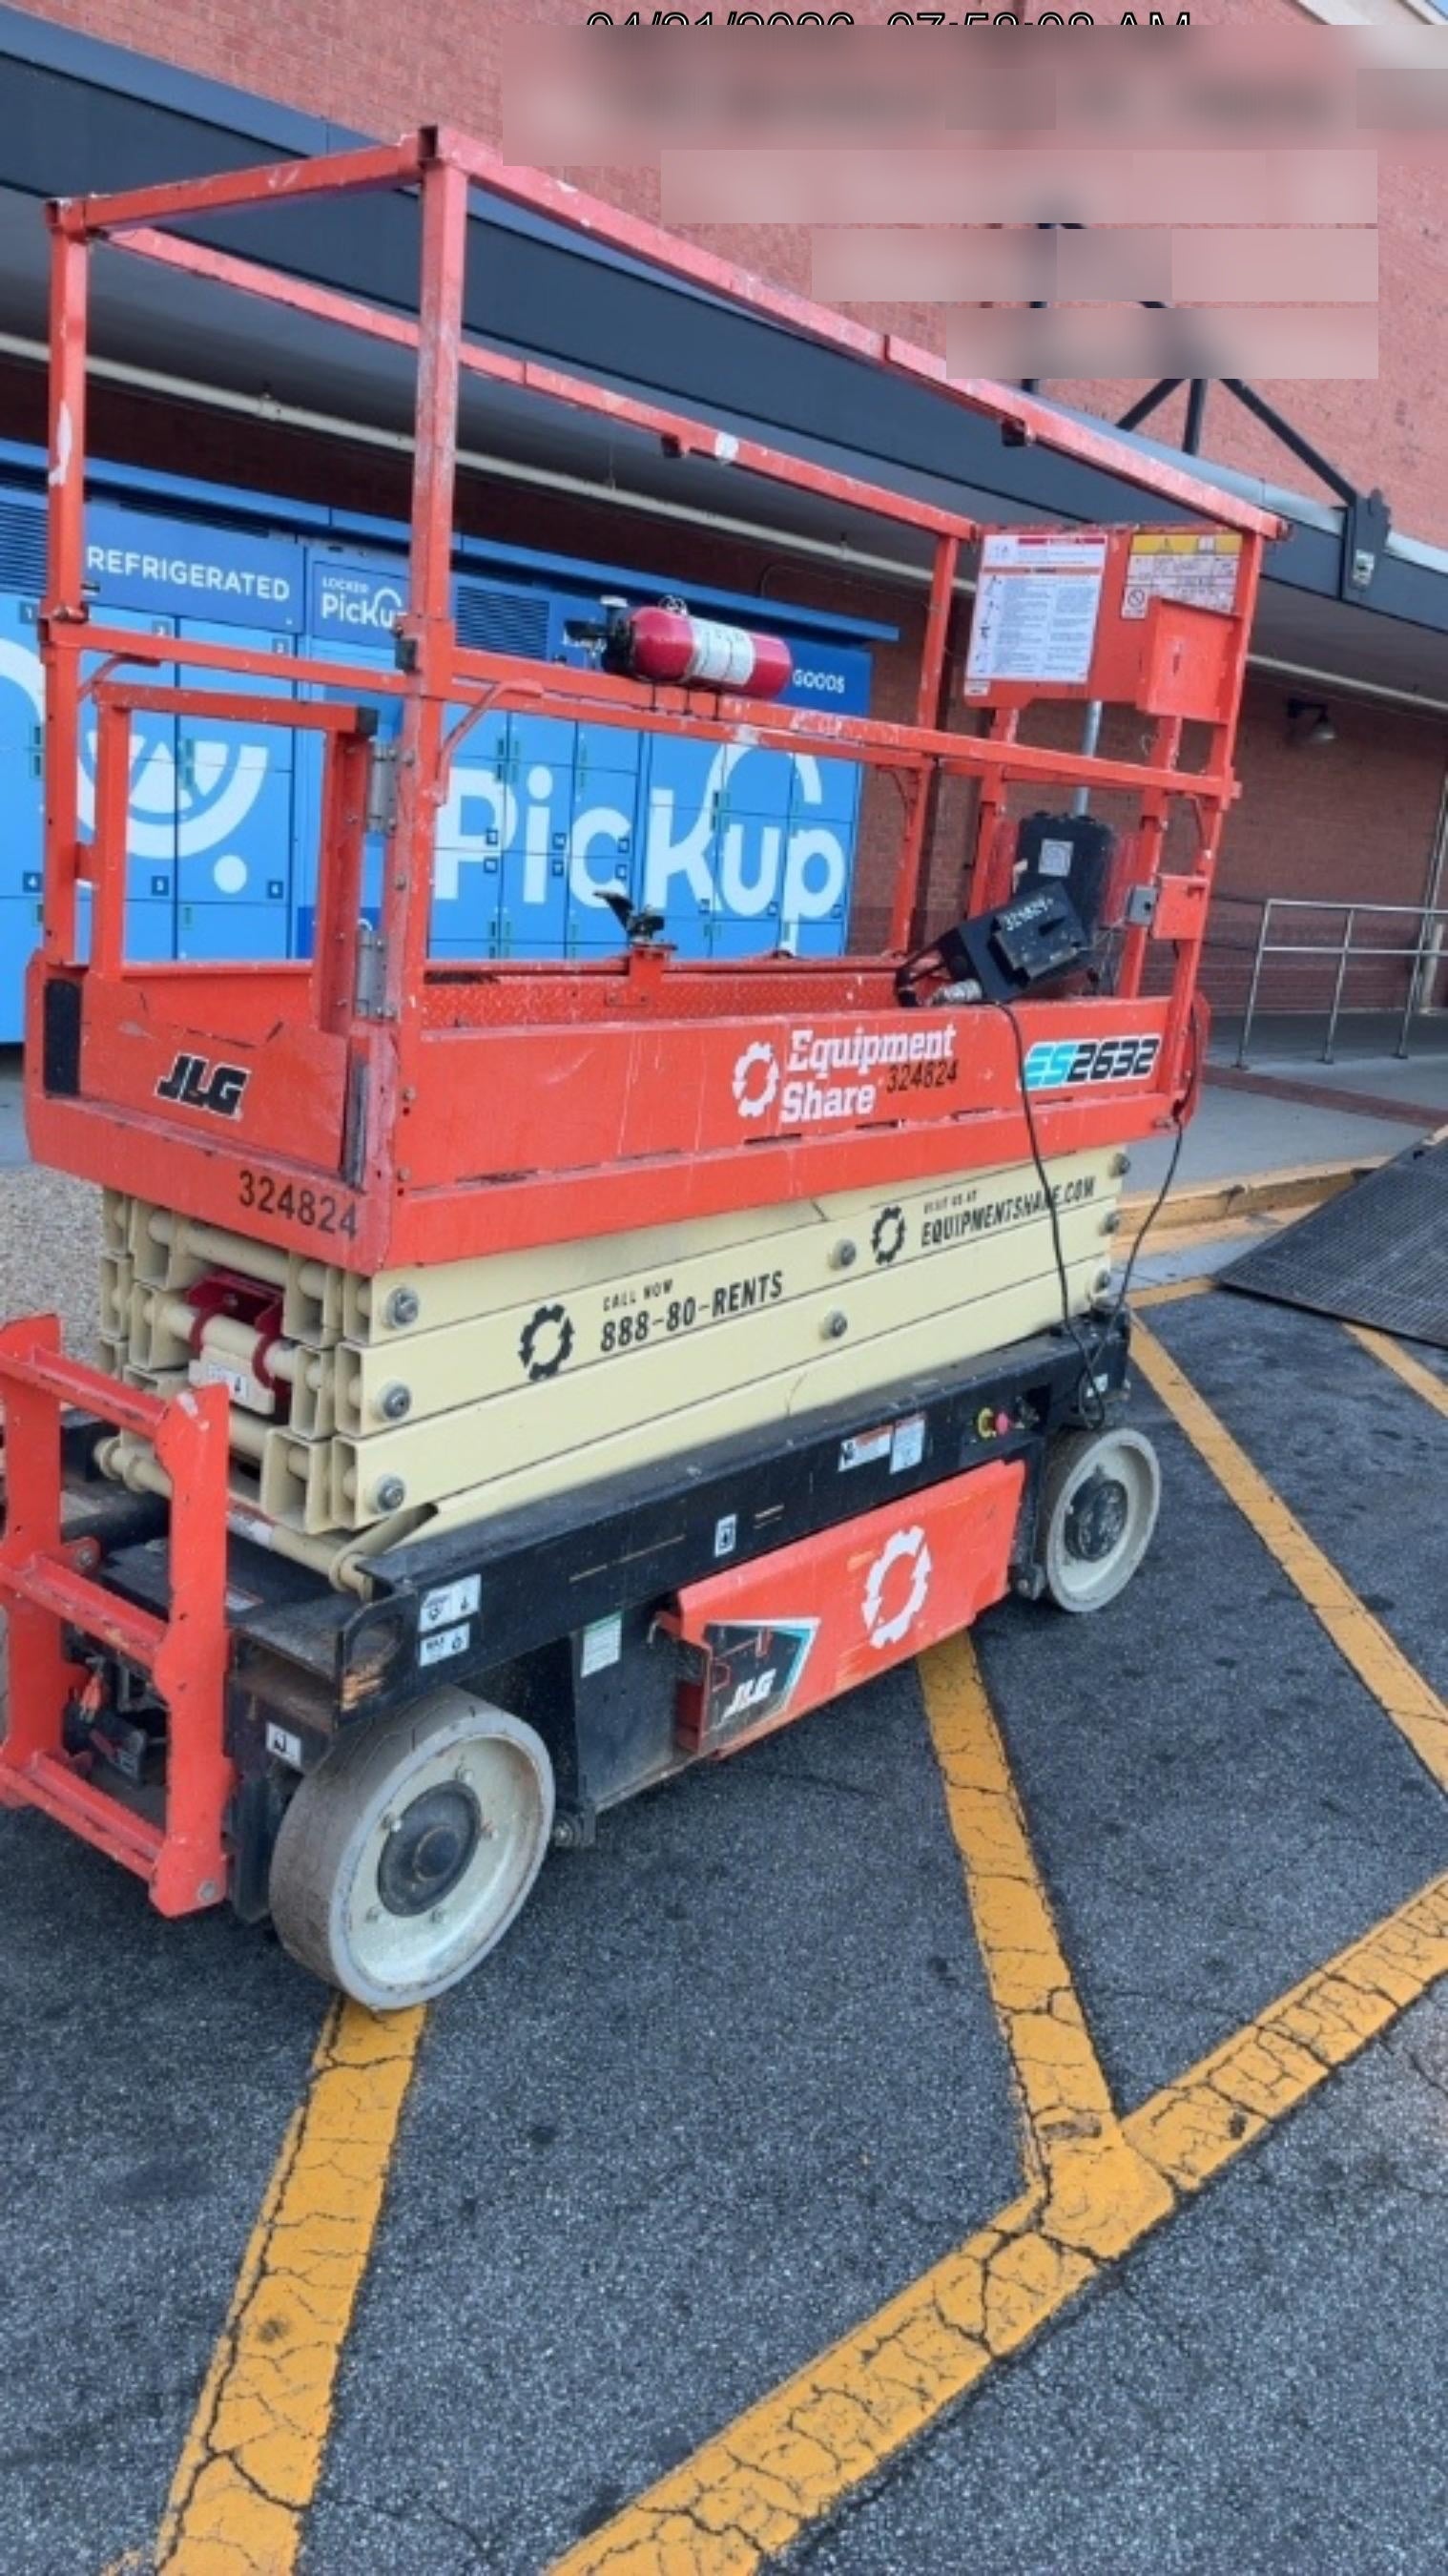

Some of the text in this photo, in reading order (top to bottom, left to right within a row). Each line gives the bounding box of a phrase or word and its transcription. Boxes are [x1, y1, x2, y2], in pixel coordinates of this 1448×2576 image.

[88, 547, 290, 601] REFRIGERATED
[322, 576, 368, 592] LOCKER
[322, 587, 407, 628] Picku
[793, 669, 845, 694] GOODS
[787, 1025, 957, 1073] Equipment
[1022, 1037, 1160, 1088] ES2632
[155, 1053, 250, 1118] JLG
[886, 1060, 958, 1093] 324824
[779, 1082, 877, 1123] Share
[238, 1170, 357, 1238] 324824
[601, 1270, 783, 1352] 888-80-RENTS
[603, 1278, 673, 1312] CALL NOW
[722, 1668, 777, 1717] JLG
